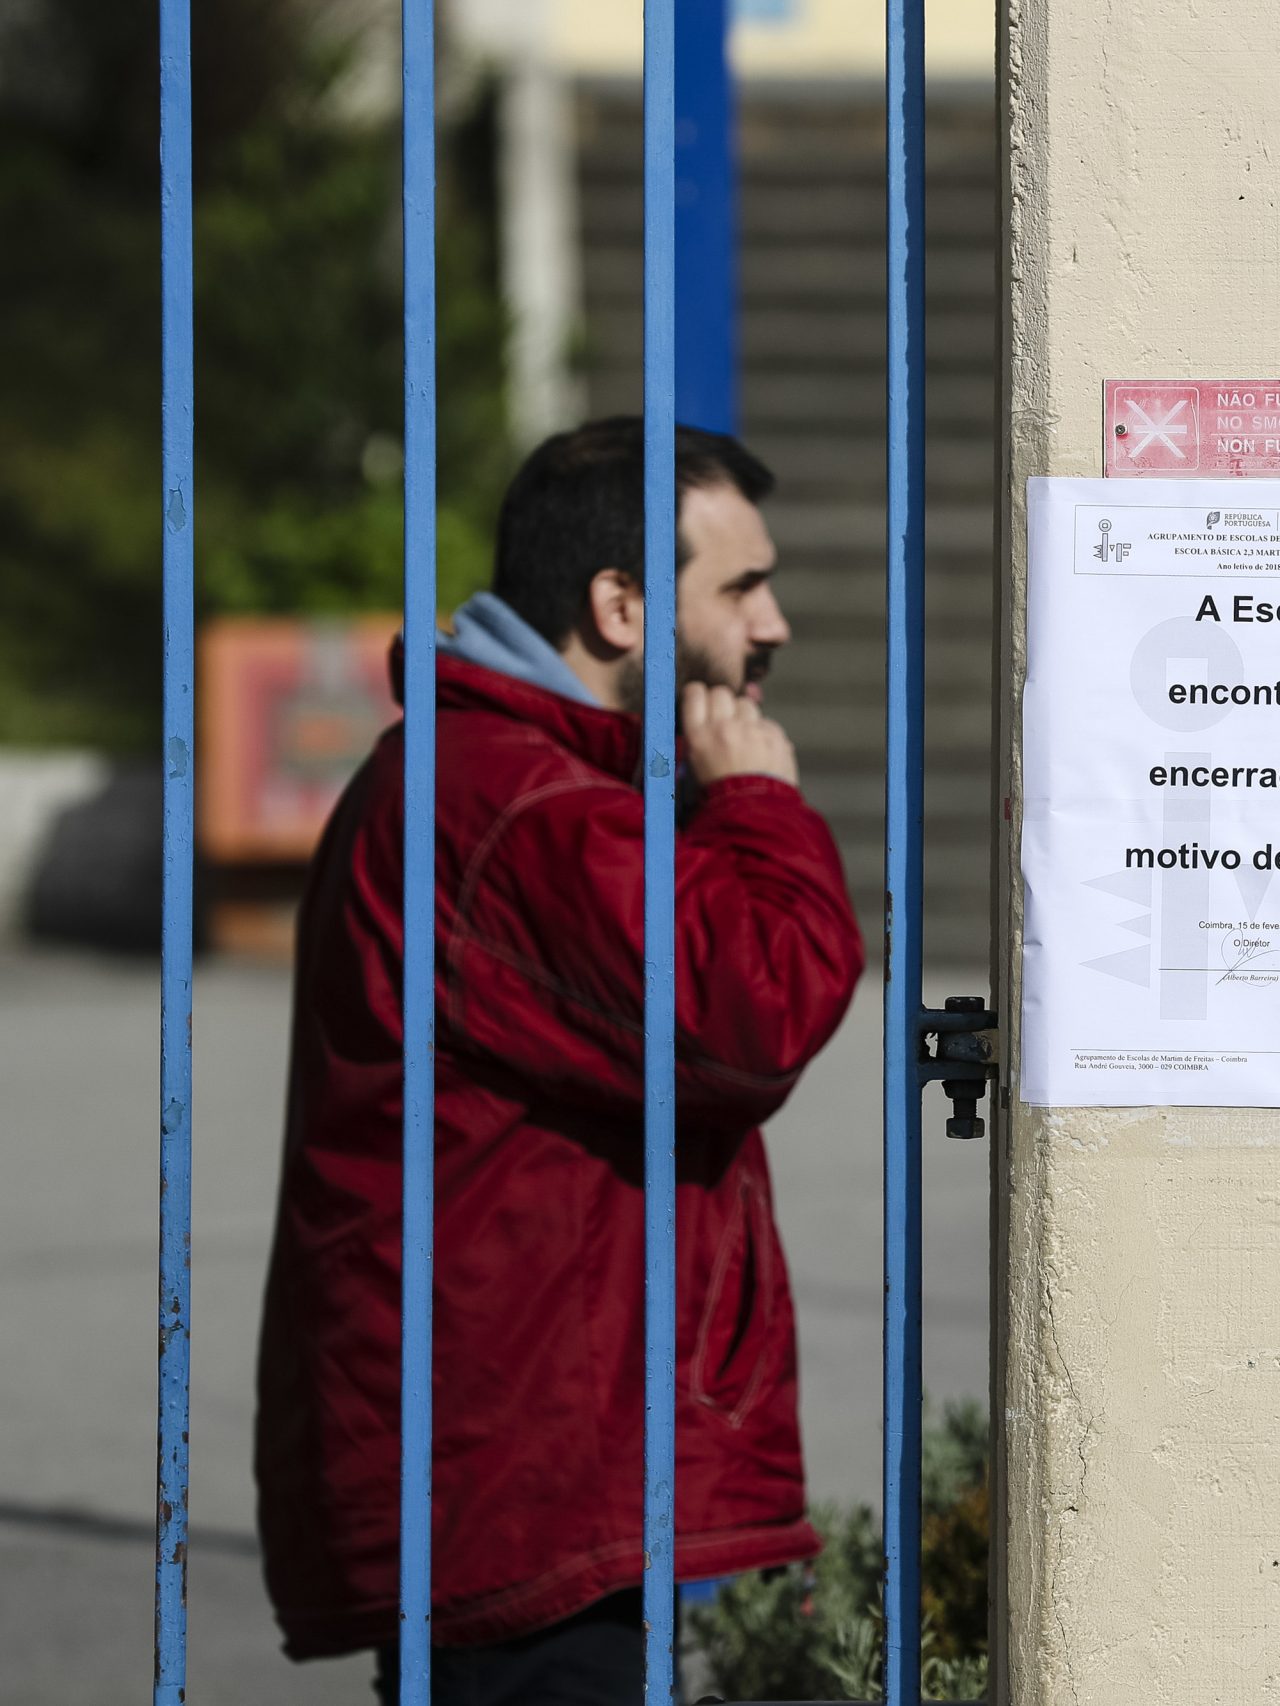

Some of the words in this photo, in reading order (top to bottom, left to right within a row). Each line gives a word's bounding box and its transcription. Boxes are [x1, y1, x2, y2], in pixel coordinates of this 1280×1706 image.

[1217, 390, 1256, 407] NÃO
[1217, 417, 1242, 429] NO
[1217, 440, 1255, 453] NON
[1147, 533, 1214, 541] AGRUPAMENTO
[1230, 534, 1268, 542] ESCOLAS
[1210, 547, 1241, 556] BÁSICA
[1243, 549, 1254, 557] 2,3
[1195, 595, 1221, 622] A
[1125, 843, 1241, 870] motivo
[1199, 921, 1235, 930] Coimbra,
[1250, 922, 1260, 930] de
[1234, 939, 1241, 947] O
[1243, 939, 1270, 947] Diretor
